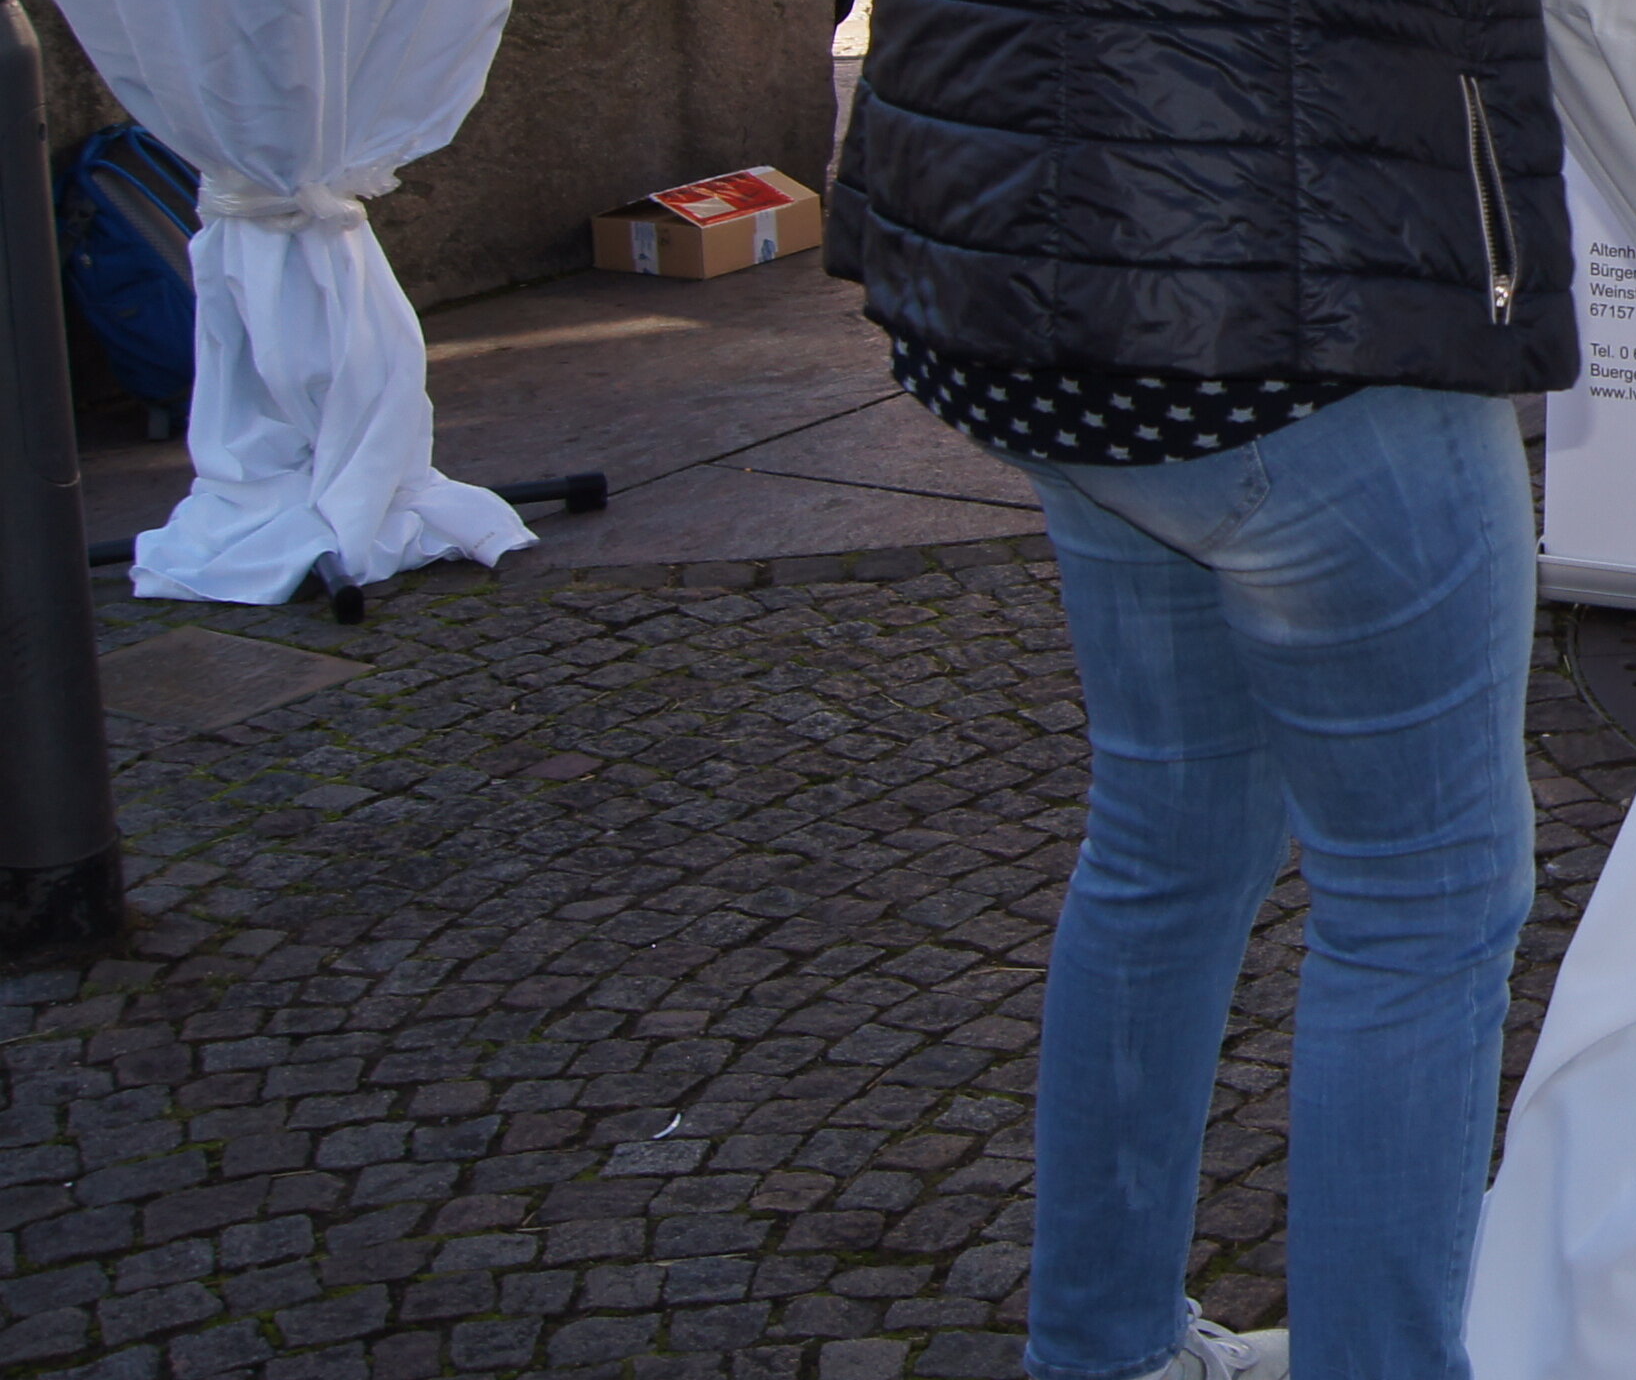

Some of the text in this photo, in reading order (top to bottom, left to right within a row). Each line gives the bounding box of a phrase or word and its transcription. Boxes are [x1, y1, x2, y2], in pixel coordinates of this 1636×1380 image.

[1590, 303, 1634, 319] 67157
[1591, 343, 1614, 359] Tel.
[1620, 346, 1629, 360] 0
